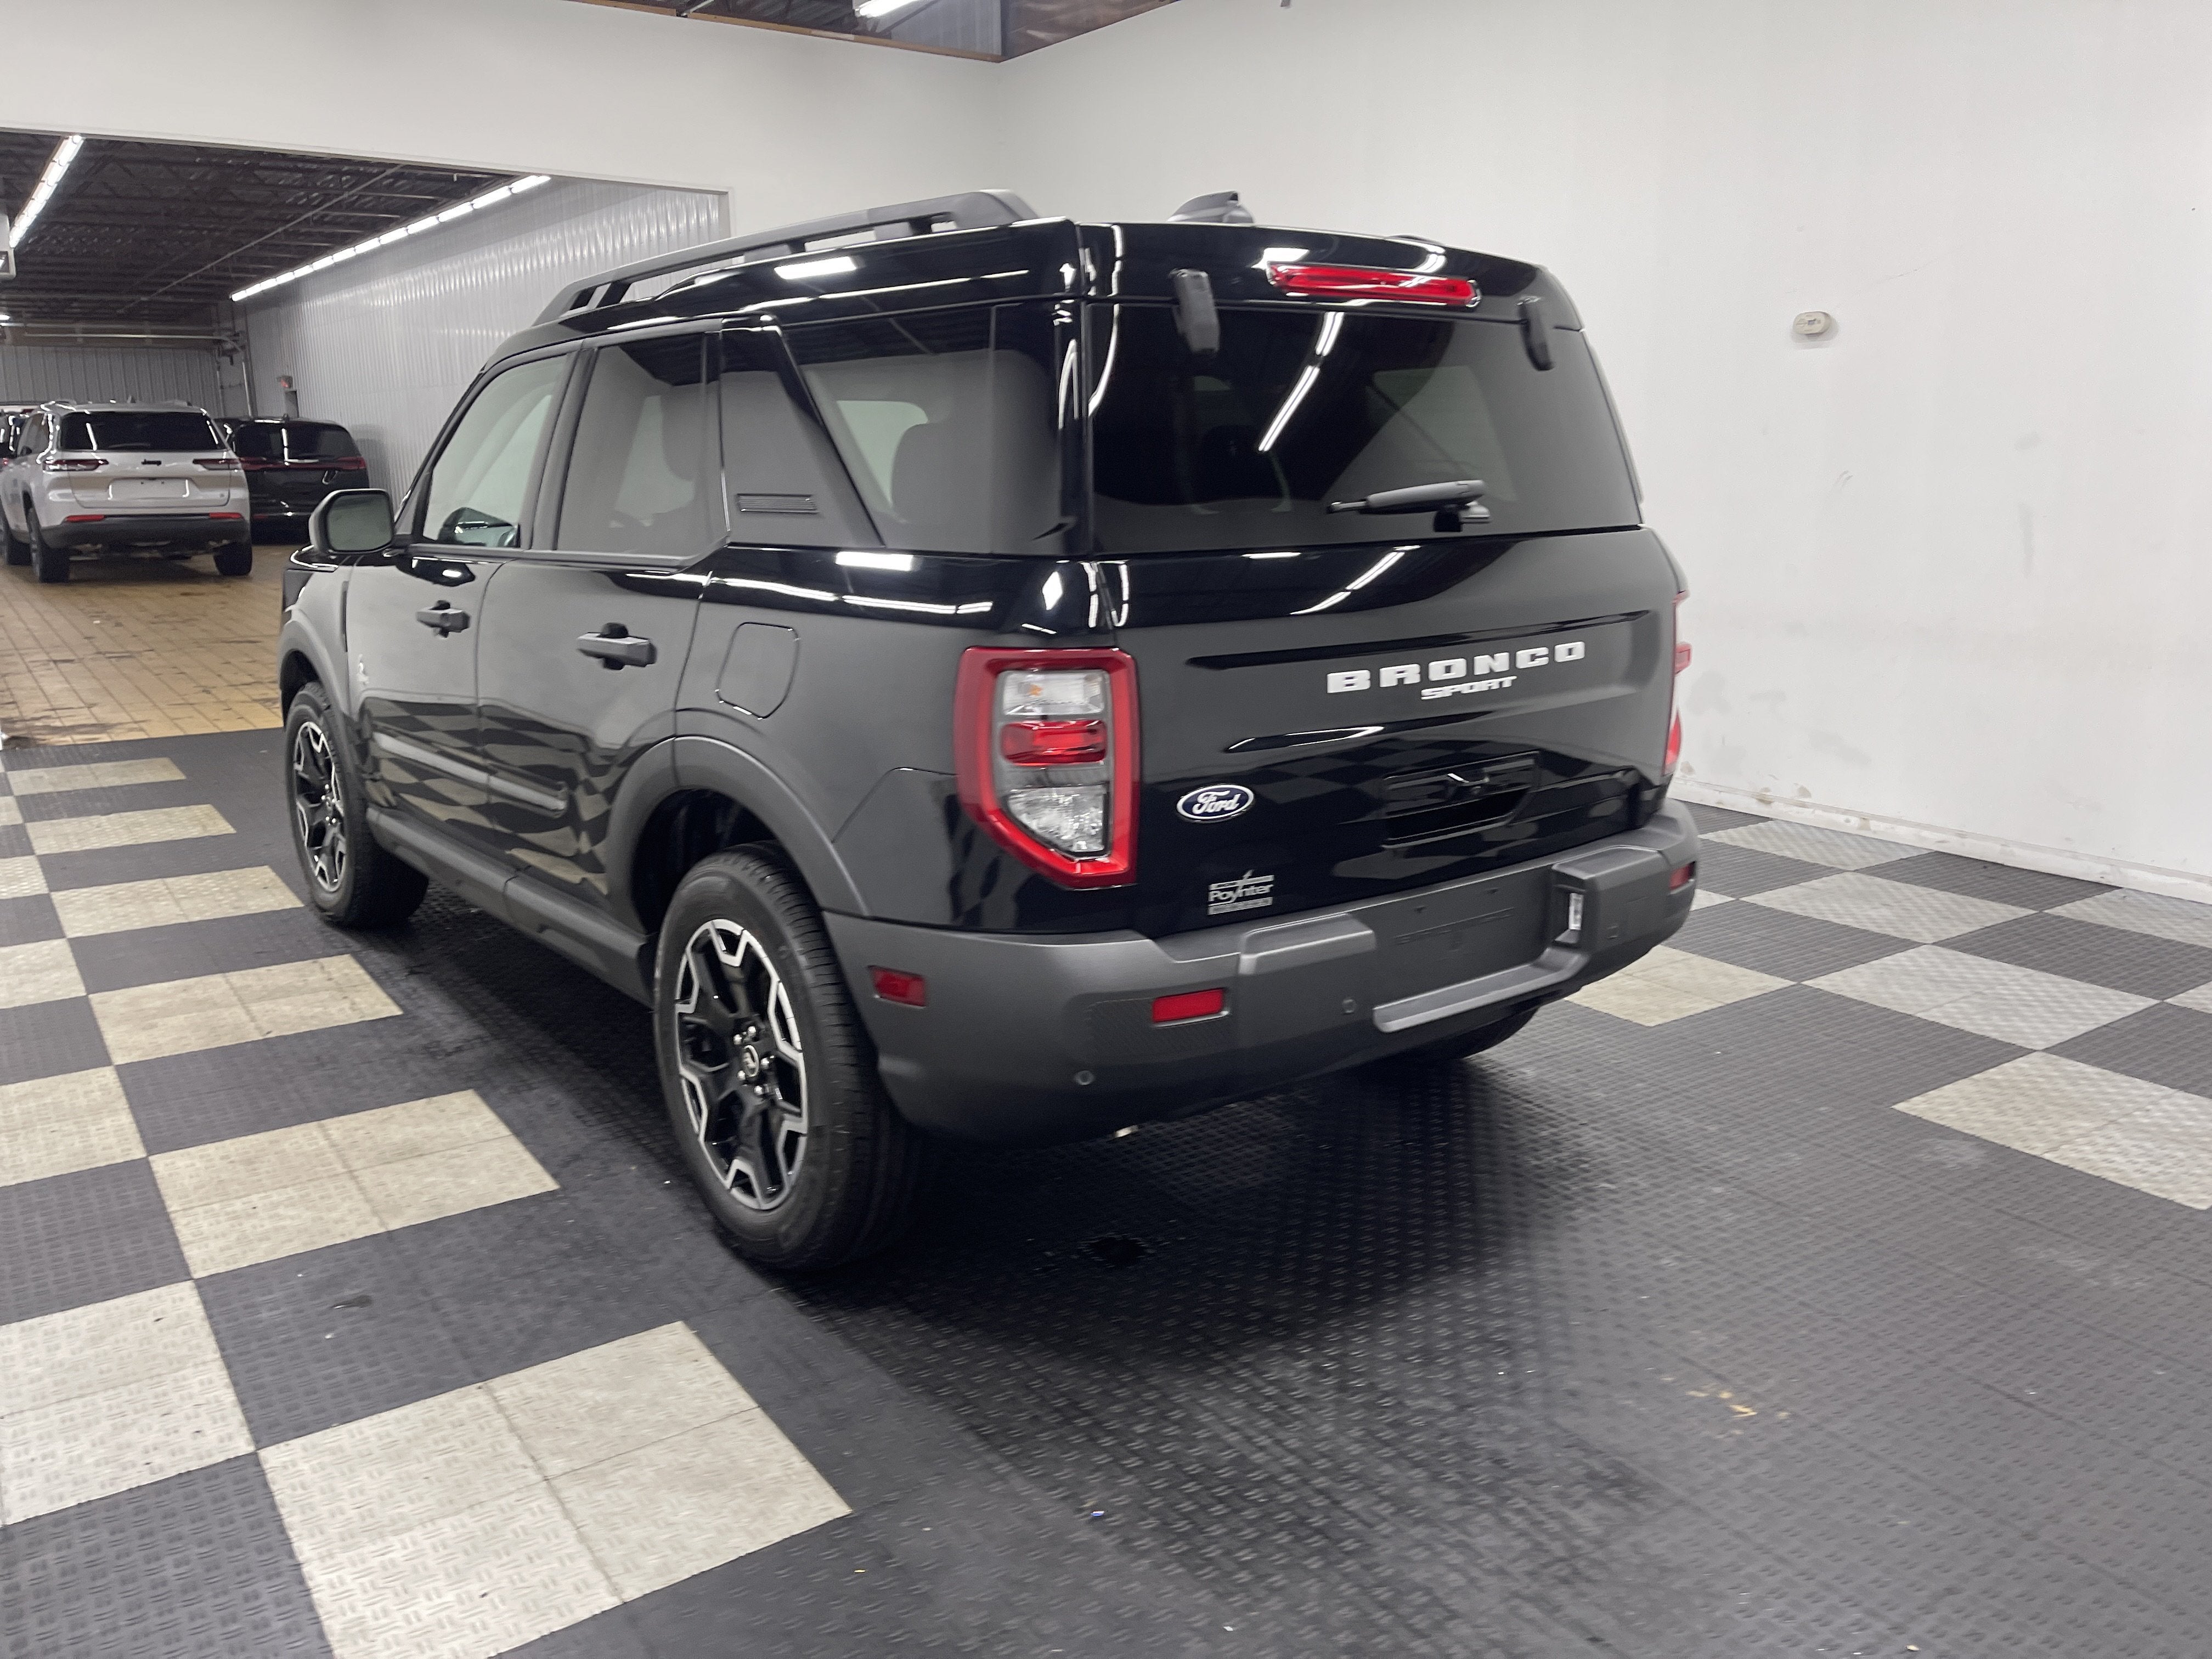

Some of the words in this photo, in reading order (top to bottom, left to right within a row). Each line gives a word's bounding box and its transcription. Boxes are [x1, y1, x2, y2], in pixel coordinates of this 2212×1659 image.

[1327, 641, 1585, 693] BRONCO
[1421, 676, 1517, 700] SPORT
[1192, 790, 1241, 814] Ford
[1207, 884, 1274, 906] Poynter
